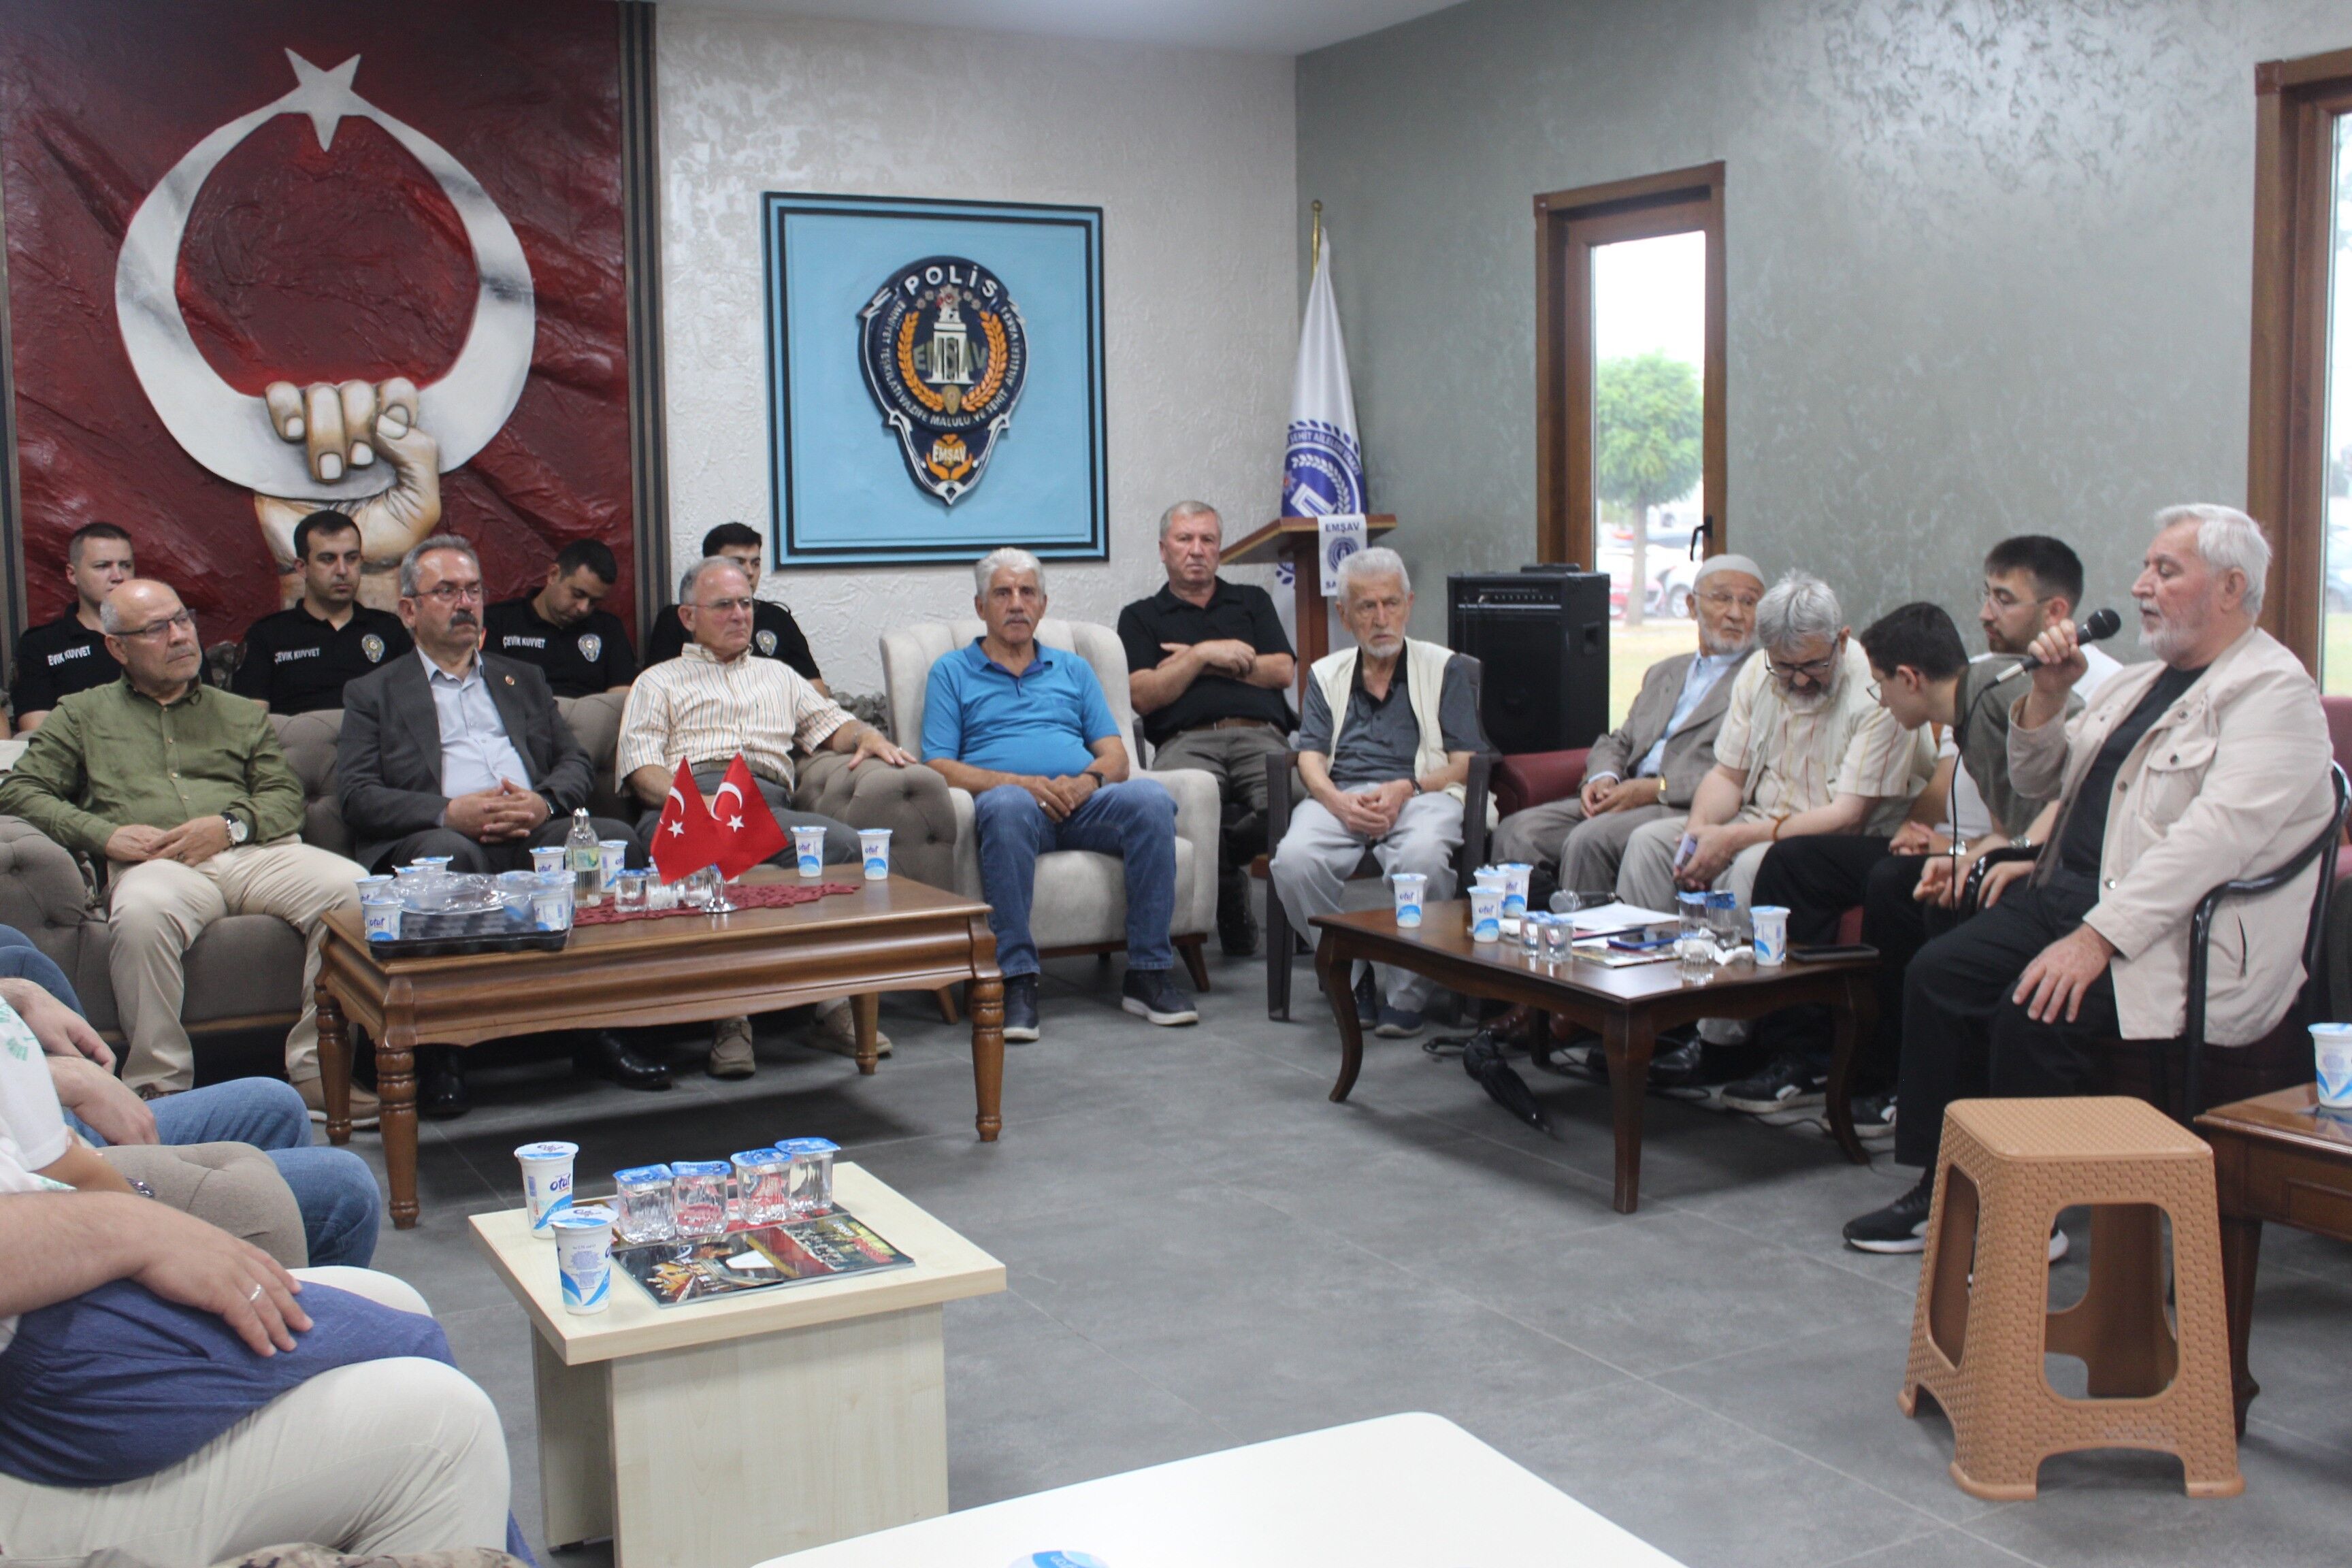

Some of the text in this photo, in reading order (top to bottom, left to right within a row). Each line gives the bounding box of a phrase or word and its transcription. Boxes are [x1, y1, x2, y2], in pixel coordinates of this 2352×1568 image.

[930, 414, 970, 427] MALULU
[972, 409, 986, 422] VE
[64, 645, 91, 660] KUVVET
[293, 647, 320, 660] KUVVET
